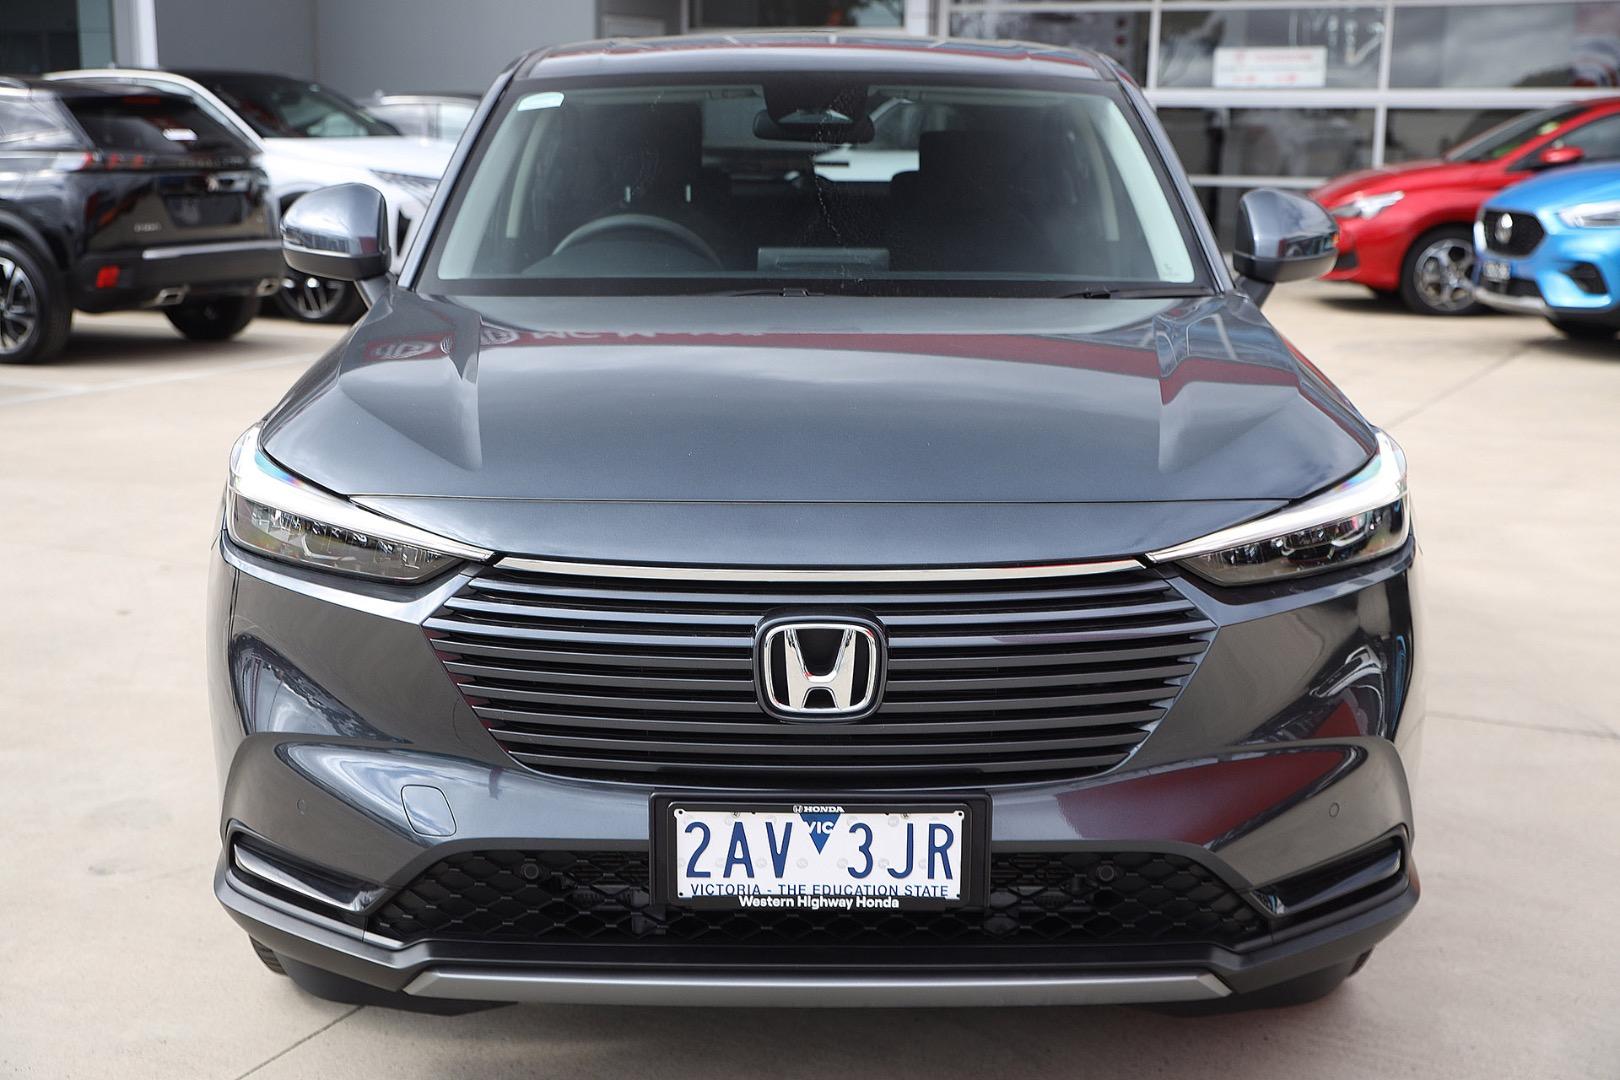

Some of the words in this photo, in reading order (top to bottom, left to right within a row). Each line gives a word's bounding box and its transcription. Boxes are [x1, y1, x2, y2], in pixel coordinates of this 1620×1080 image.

[803, 821, 834, 835] VIC
[685, 821, 793, 879] 2AV
[848, 823, 954, 880] 3JR
[690, 884, 761, 896] VICTORIA
[778, 884, 806, 896] THE
[812, 884, 898, 896] EDUCATION
[904, 885, 949, 897] STATE
[738, 895, 795, 908] Western
[797, 895, 854, 910] Highway
[856, 896, 900, 909] Honda
